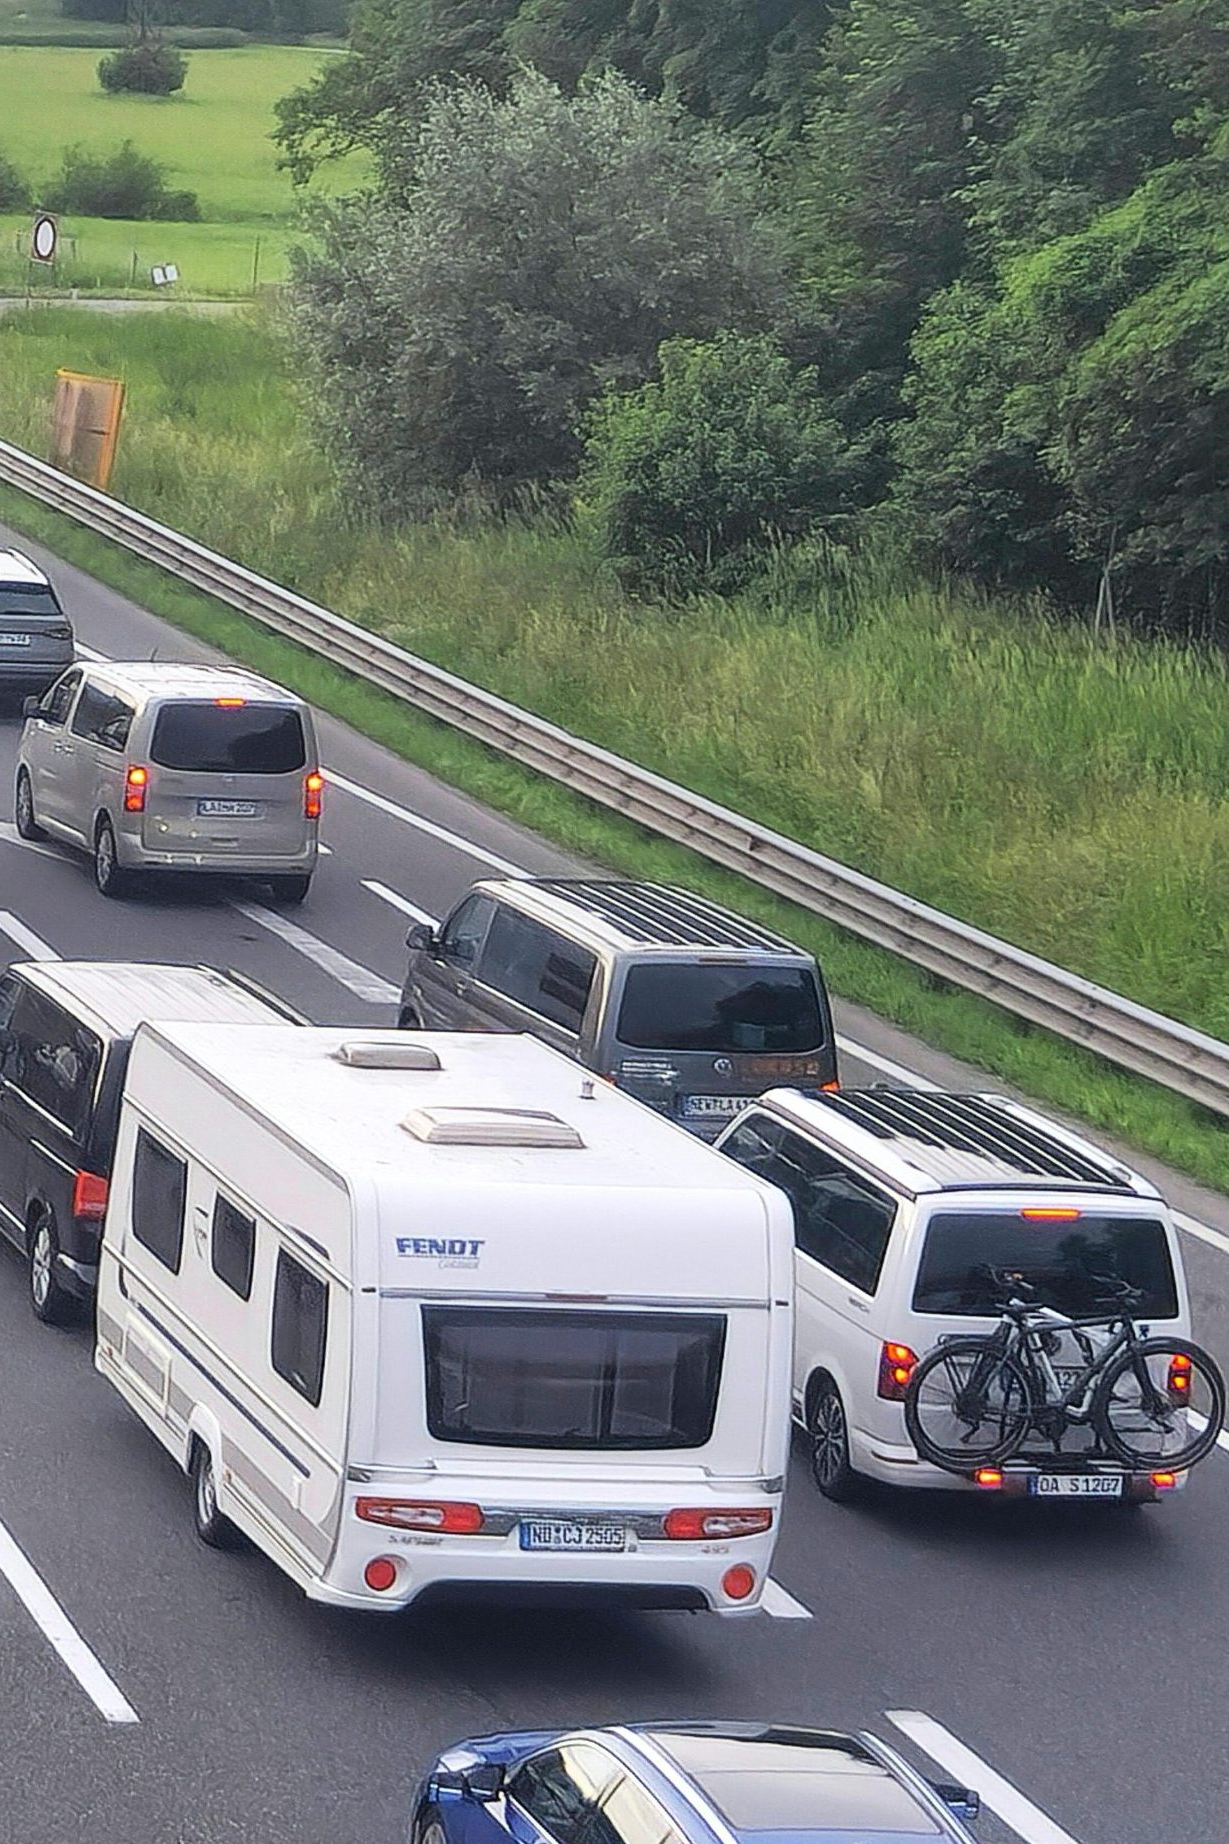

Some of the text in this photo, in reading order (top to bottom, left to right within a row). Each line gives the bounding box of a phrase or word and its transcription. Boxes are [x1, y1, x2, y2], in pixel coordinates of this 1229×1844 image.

[396, 1238, 485, 1256] FENDT
[1039, 1477, 1120, 1492] OA S 1207
[563, 1527, 582, 1544] CJ
[585, 1527, 623, 1545] 2505
